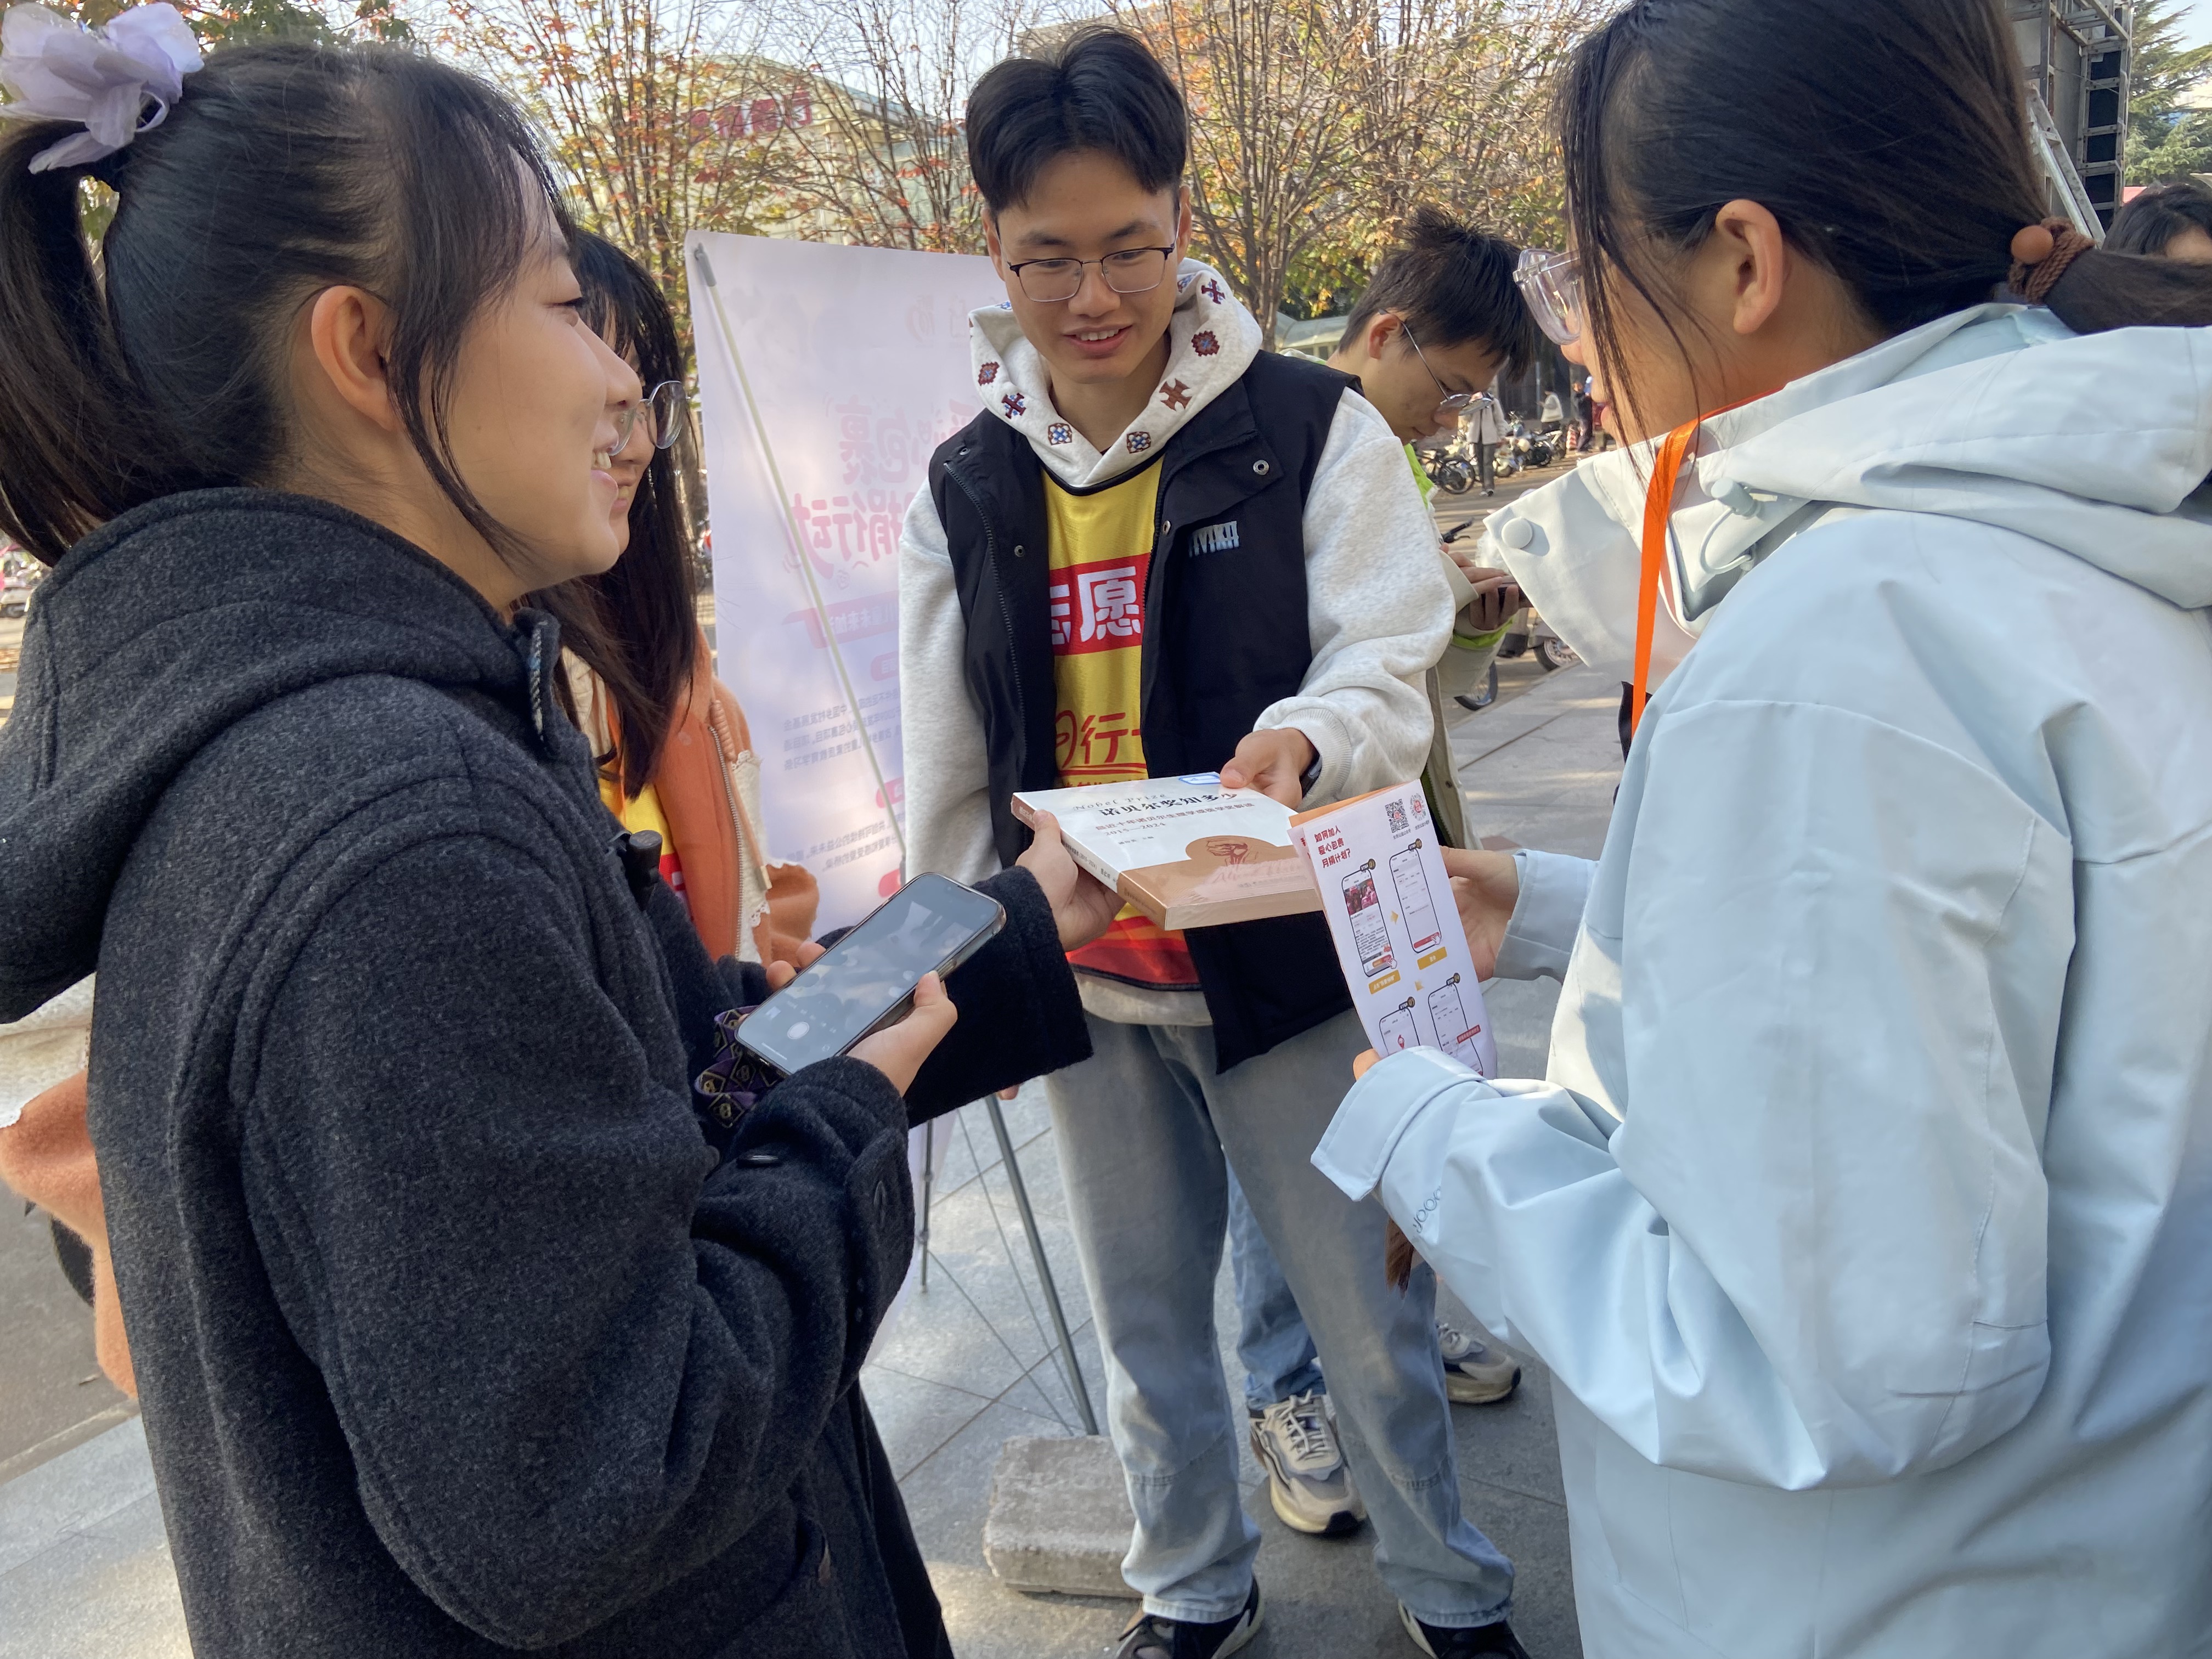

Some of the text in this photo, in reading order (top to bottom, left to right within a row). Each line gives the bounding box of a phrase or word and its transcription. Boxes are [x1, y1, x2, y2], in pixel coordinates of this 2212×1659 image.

[1073, 794, 1167, 811] Nobel Prize
[1098, 793, 1238, 817] 诺贝尔奖知多少
[1318, 837, 1345, 855] 爱心包裹
